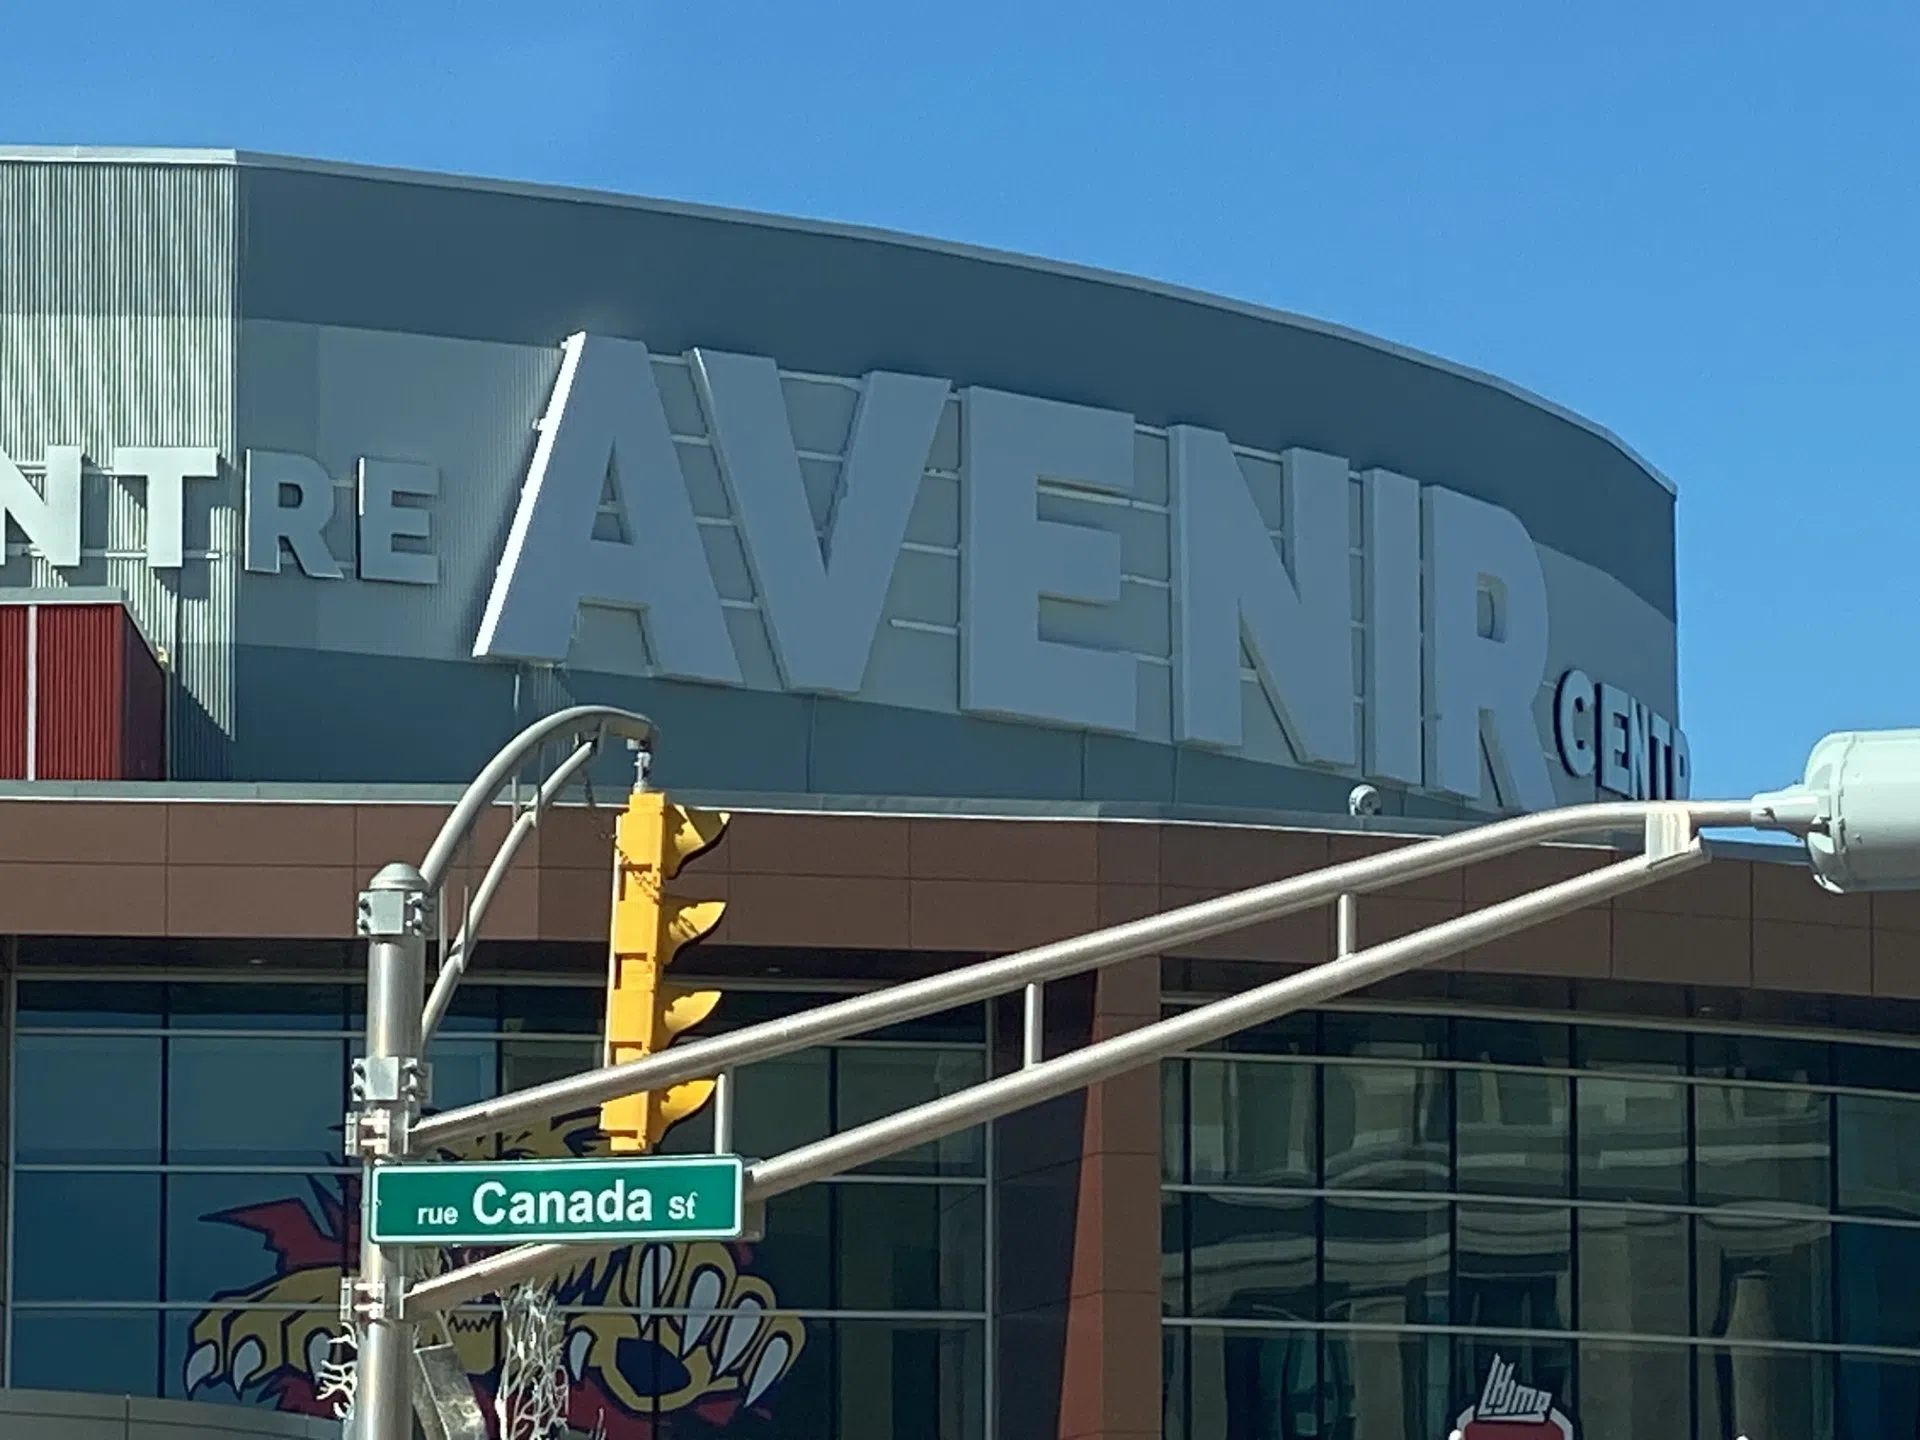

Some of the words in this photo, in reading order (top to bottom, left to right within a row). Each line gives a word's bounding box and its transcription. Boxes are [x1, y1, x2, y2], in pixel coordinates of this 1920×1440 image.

[473, 331, 1557, 812] AVENIR
[416, 1206, 459, 1225] rue
[472, 1179, 653, 1225] Canada
